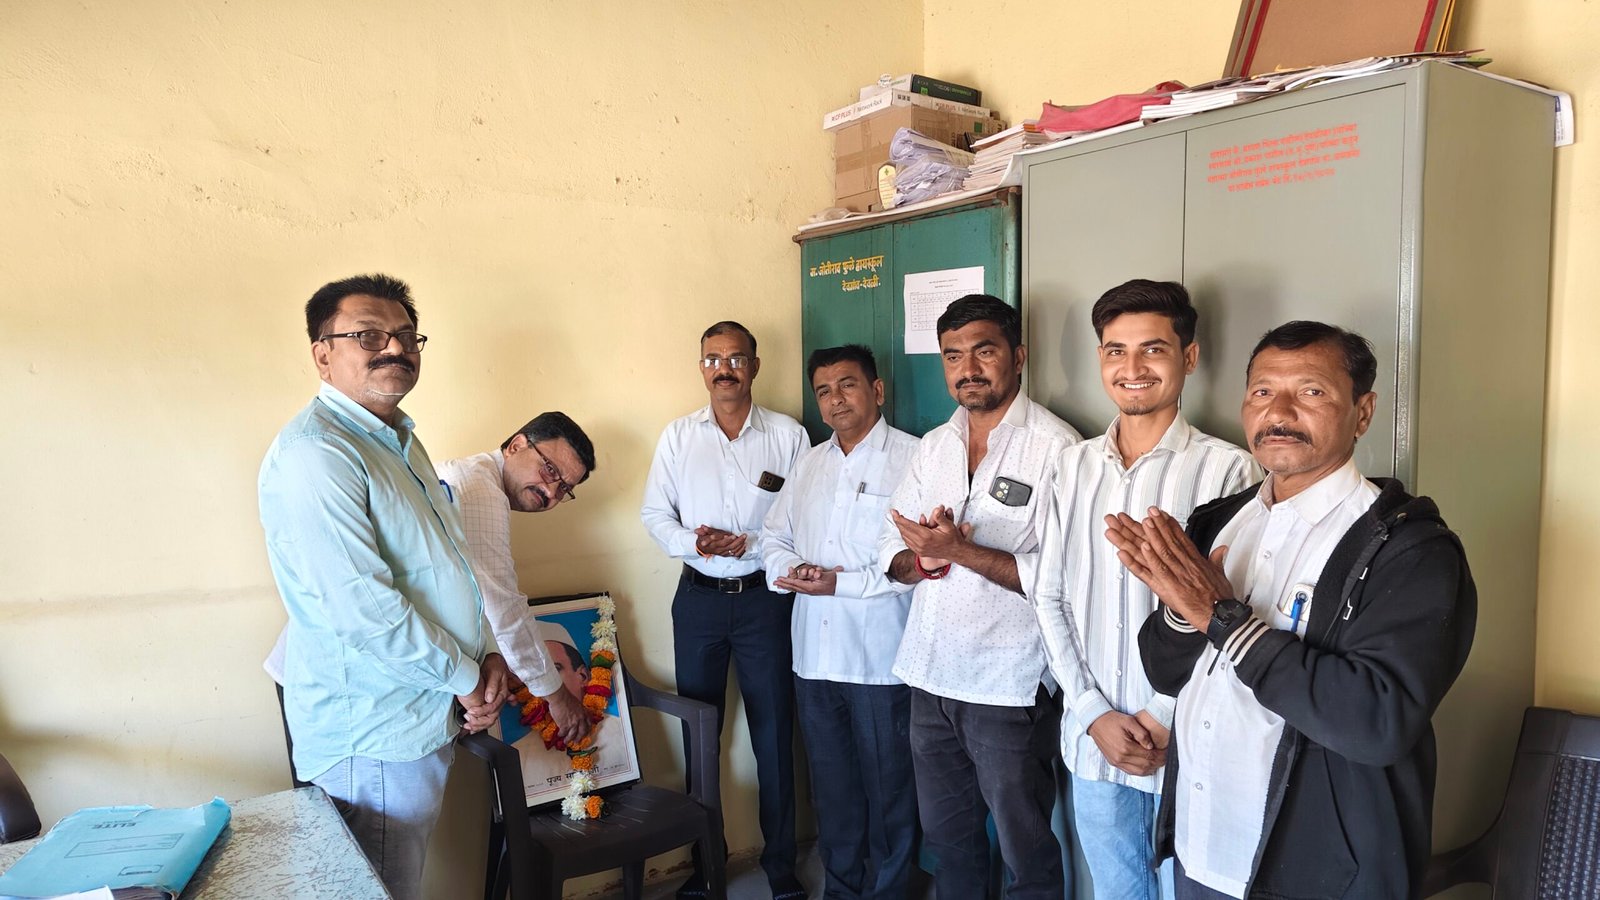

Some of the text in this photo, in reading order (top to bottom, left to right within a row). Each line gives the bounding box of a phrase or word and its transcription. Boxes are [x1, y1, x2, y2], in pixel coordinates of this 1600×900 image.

[842, 256, 855, 276] फुले
[855, 255, 885, 273] हायस्कूल
[546, 774, 562, 786] पूज्य
[92, 822, 137, 830] ELITE
